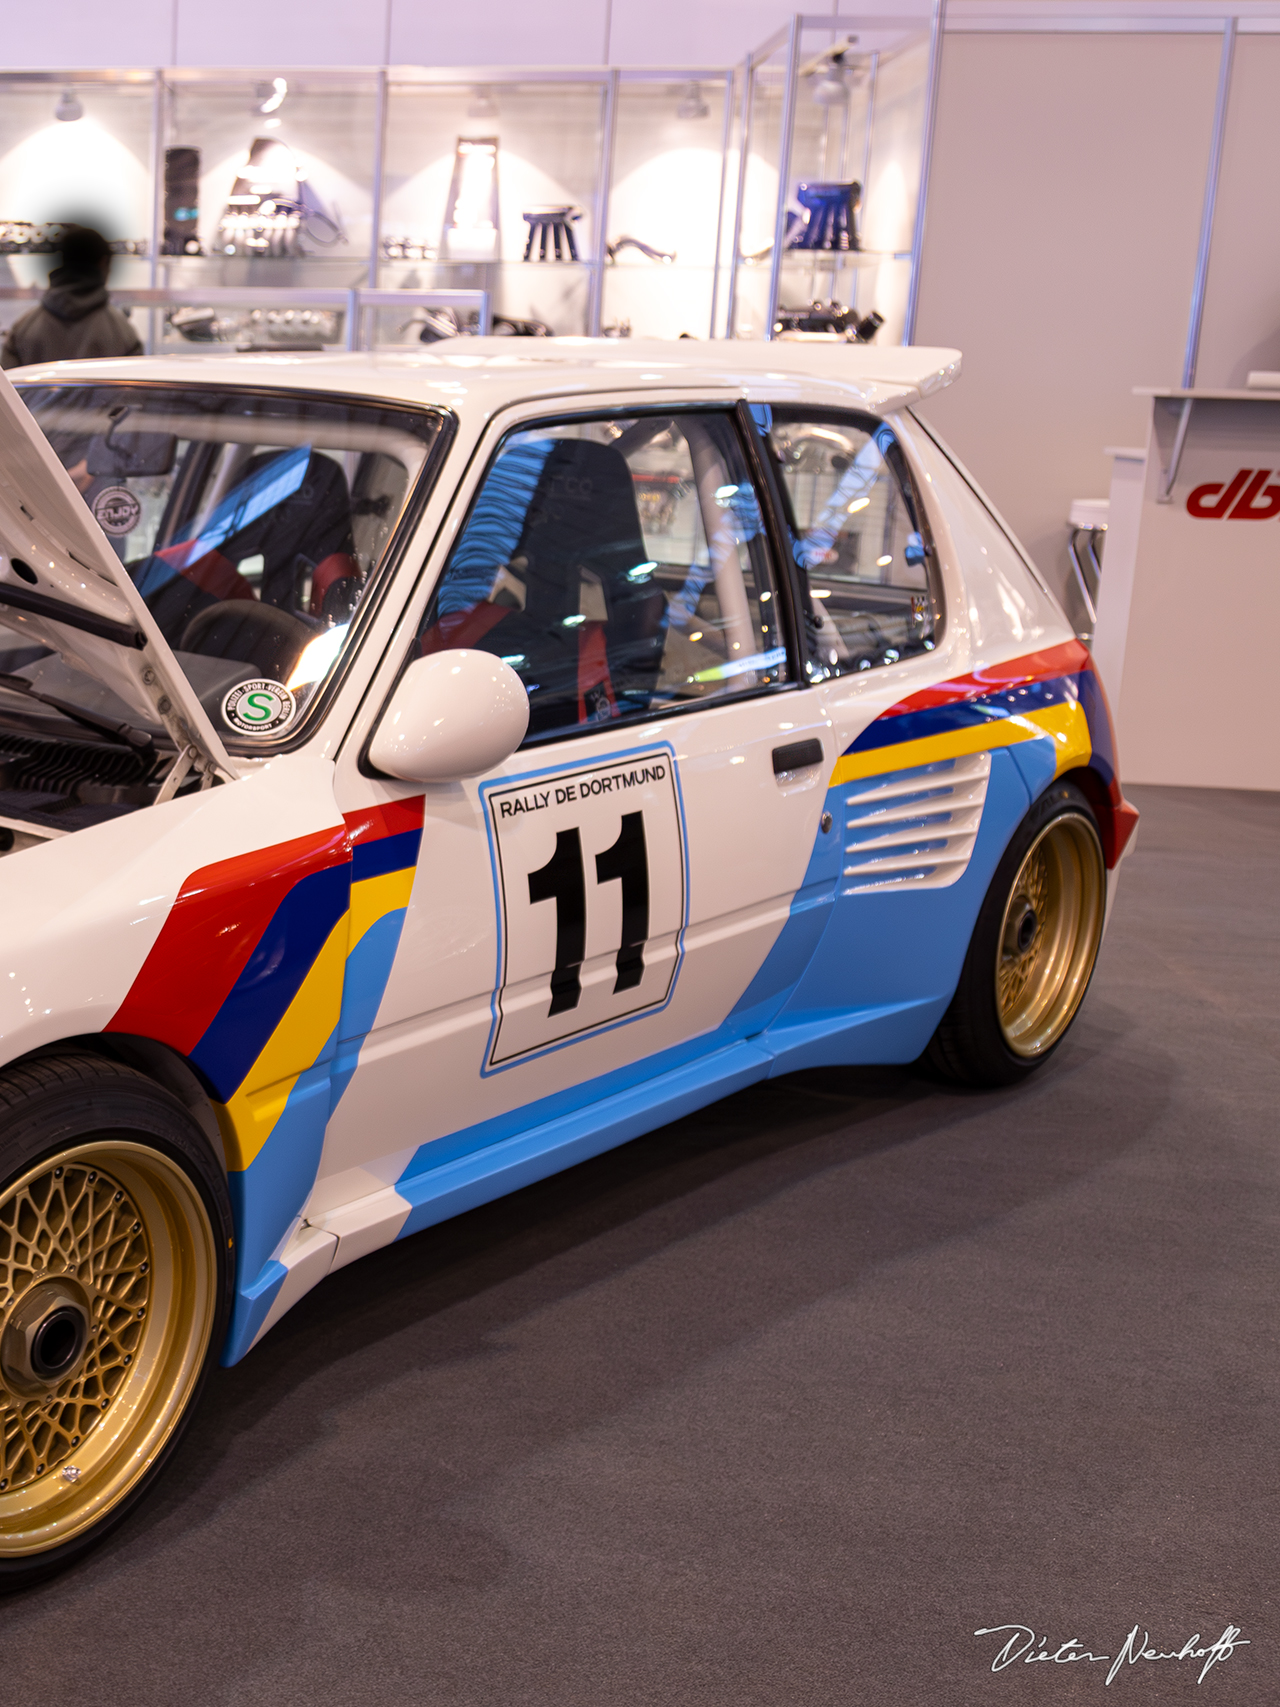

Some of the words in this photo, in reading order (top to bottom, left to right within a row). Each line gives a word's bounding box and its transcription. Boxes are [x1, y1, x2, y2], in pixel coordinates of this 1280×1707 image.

[242, 693, 274, 722] S
[500, 790, 551, 818] RALLY
[555, 785, 577, 805] DE
[580, 764, 666, 798] DORTMUND
[527, 809, 650, 1018] 11
